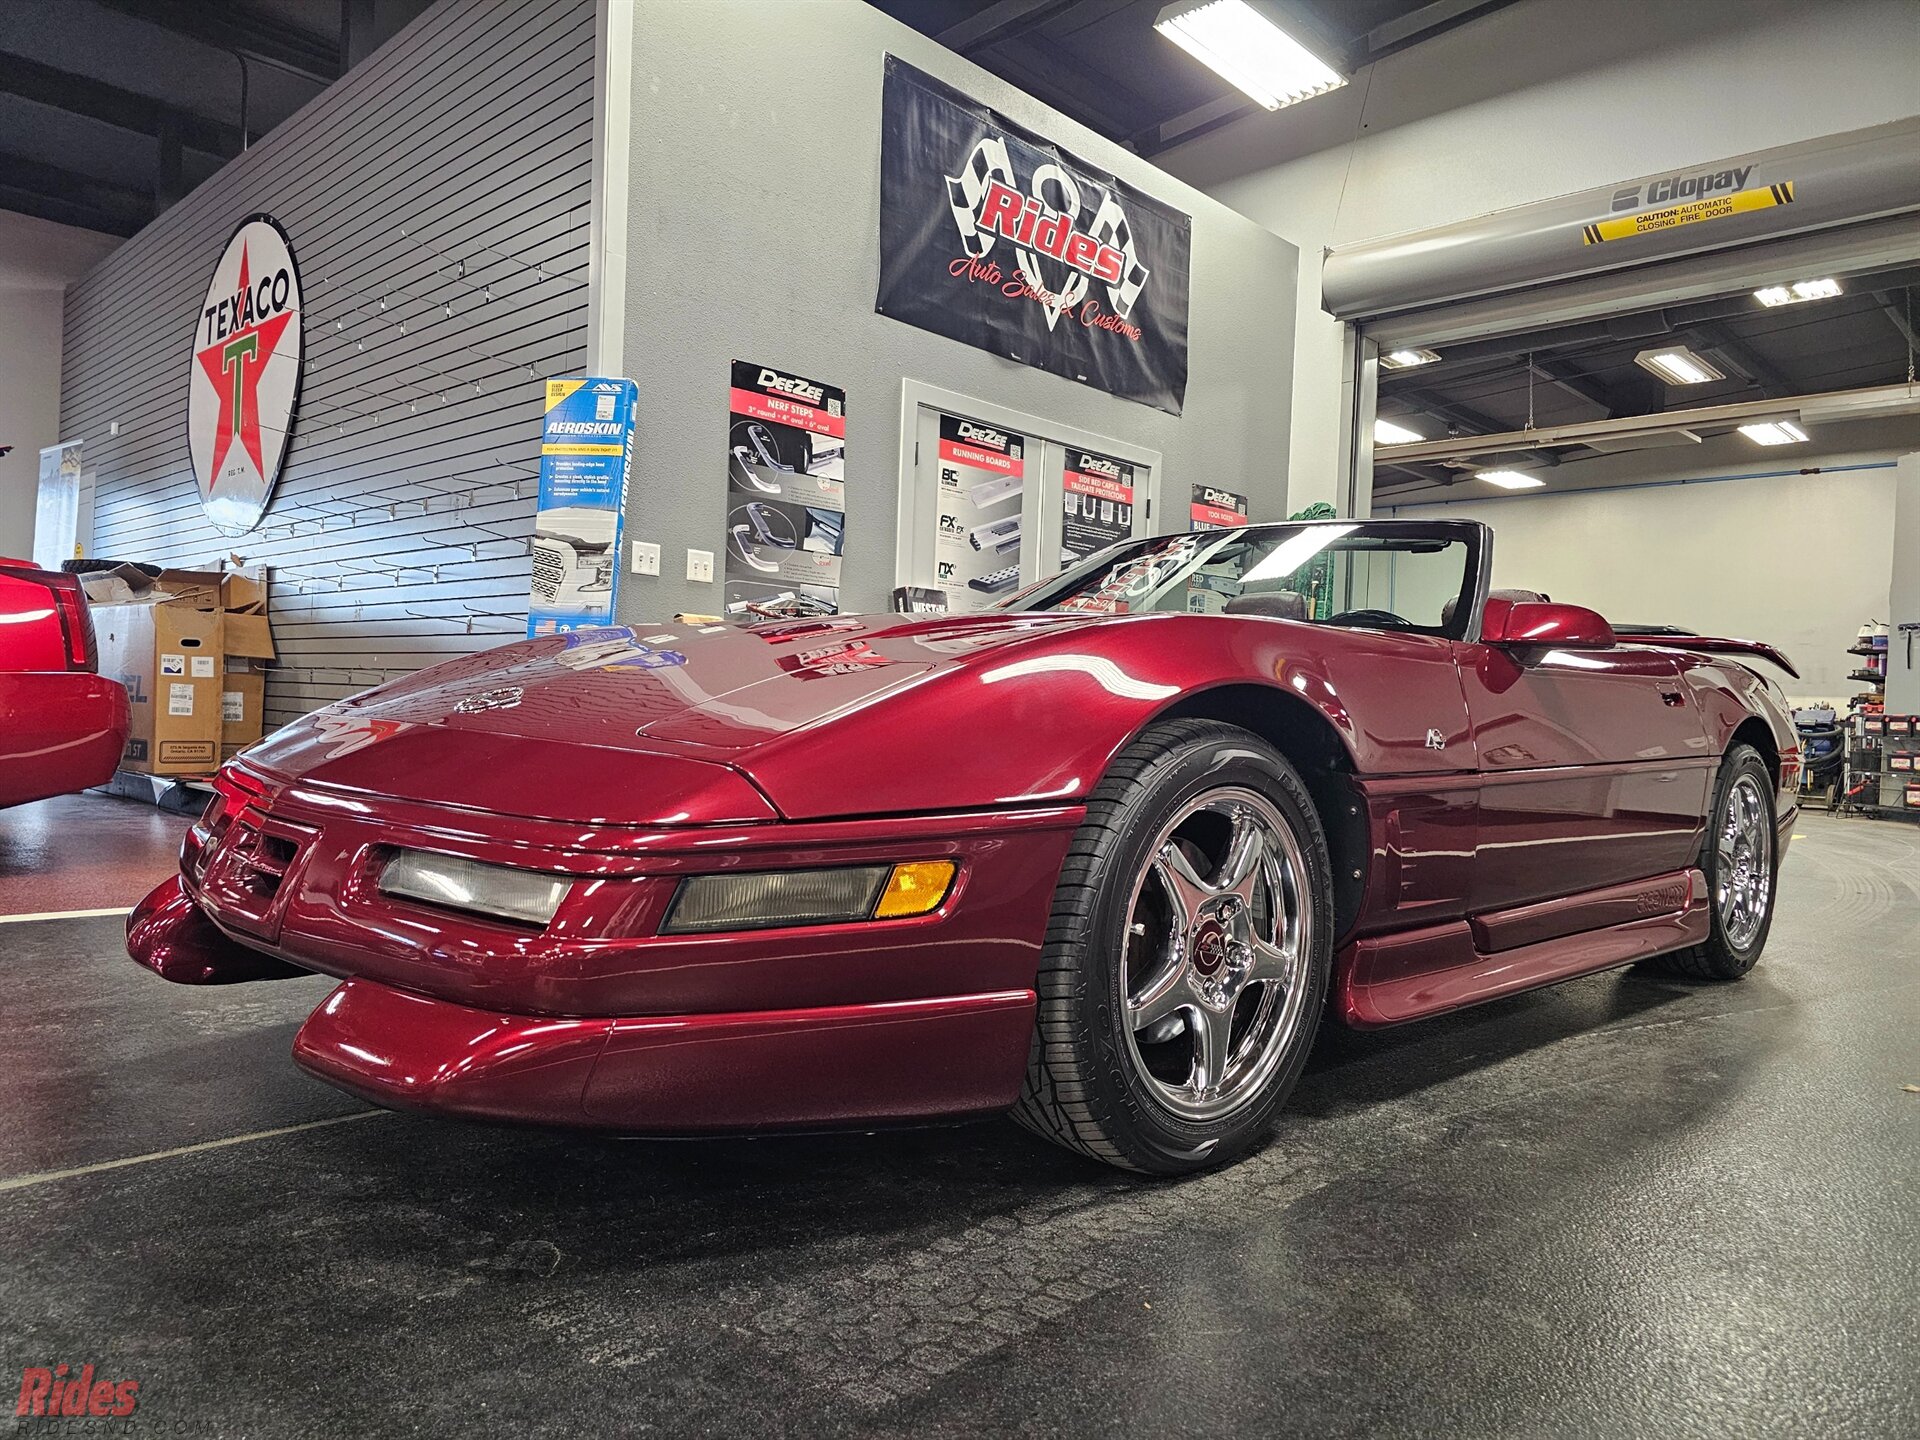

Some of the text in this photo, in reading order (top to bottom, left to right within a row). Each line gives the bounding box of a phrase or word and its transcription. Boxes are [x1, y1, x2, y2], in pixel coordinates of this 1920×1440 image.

[1647, 165, 1753, 204] Clopay
[1636, 197, 1732, 224] CAUTION: AUTOMATIC
[1636, 205, 1733, 232] CLOSING FIRE DOOR
[976, 177, 1127, 286] Rides
[948, 252, 1142, 341] Auto Sales & Customs
[204, 267, 290, 346] TEXACO
[757, 408, 776, 418] round
[791, 417, 804, 425] oval
[767, 399, 814, 418] NERF STEPS
[546, 422, 623, 435] AEROSKIN
[952, 447, 1011, 469] RUNNING BOARDS
[942, 467, 958, 482] BC
[1078, 475, 1090, 485] SIDE
[1091, 478, 1101, 487] BED
[1102, 481, 1114, 491] CAPS
[1071, 482, 1126, 501] TAILGATE PROTECTORS
[940, 514, 956, 529] FX
[1193, 521, 1210, 531] BLUE
[1208, 511, 1234, 522] TOOL BOXES
[1191, 573, 1204, 583] RED
